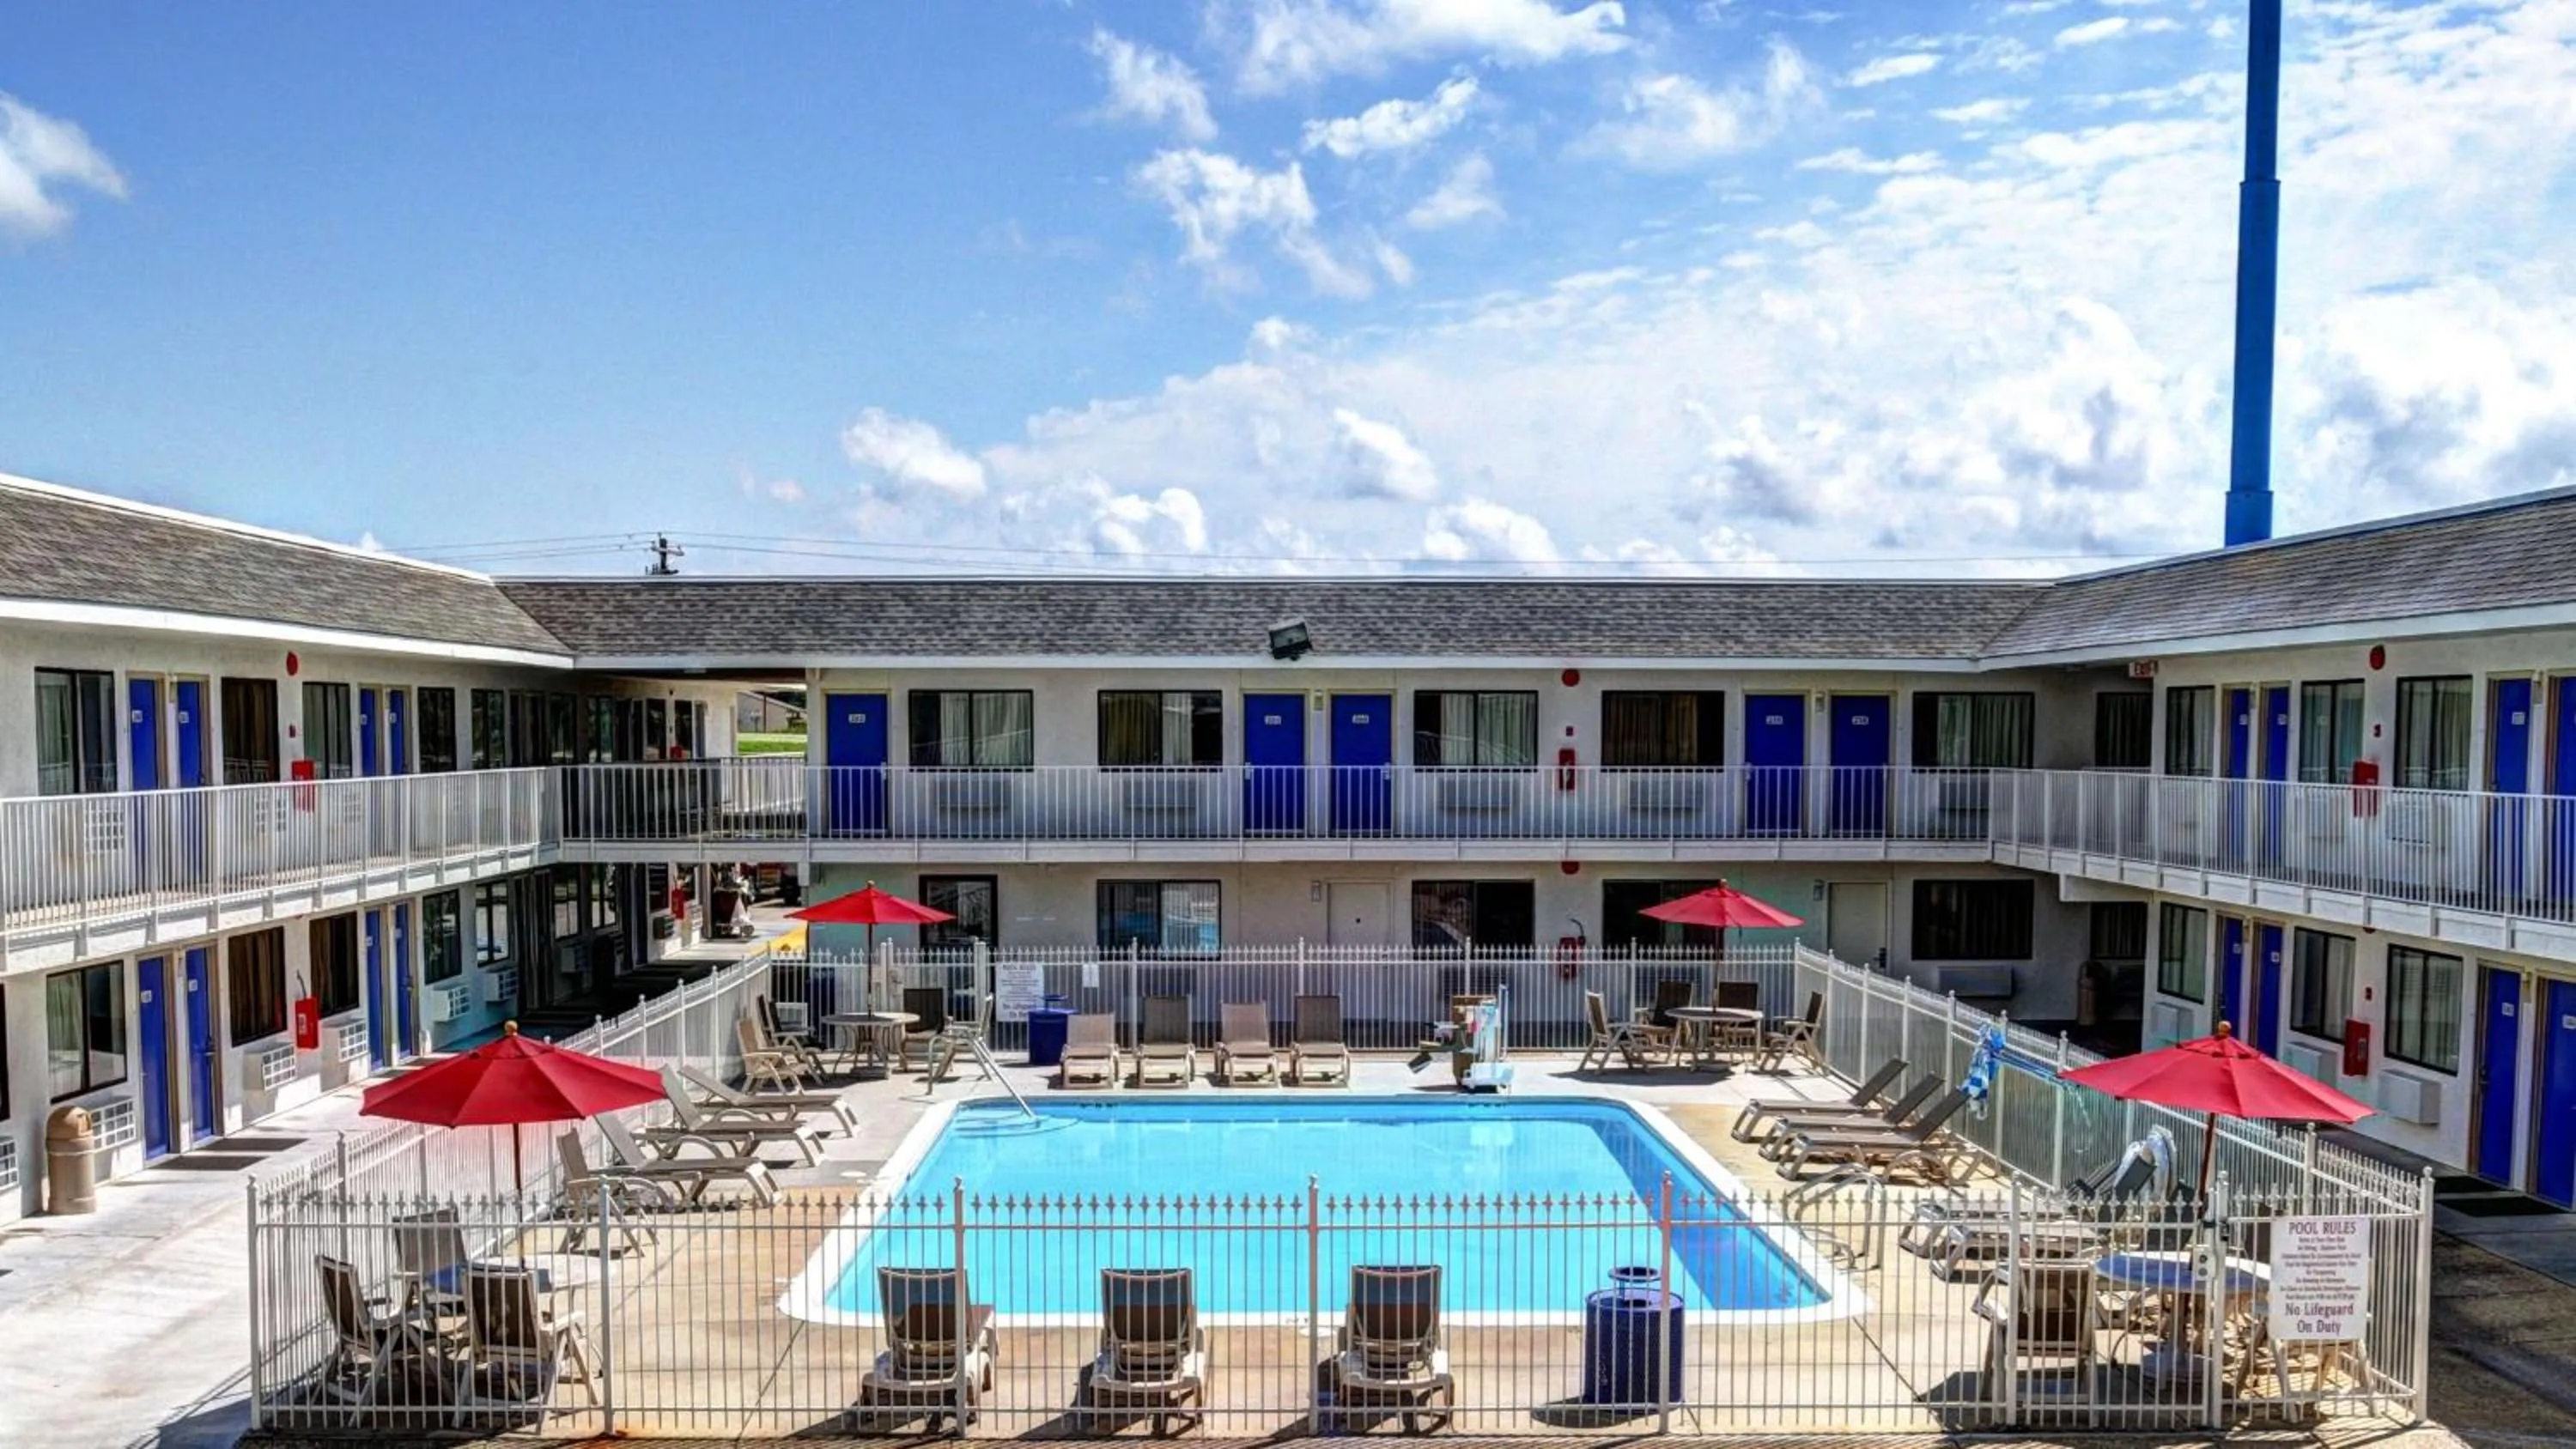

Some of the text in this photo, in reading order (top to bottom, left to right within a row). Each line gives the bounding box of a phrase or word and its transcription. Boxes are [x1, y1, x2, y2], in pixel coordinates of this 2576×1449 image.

[2288, 1221, 2356, 1235] POOL RULES
[2285, 1302, 2354, 1319] No Lifeguard
[2297, 1319, 2342, 1337] On Duty
